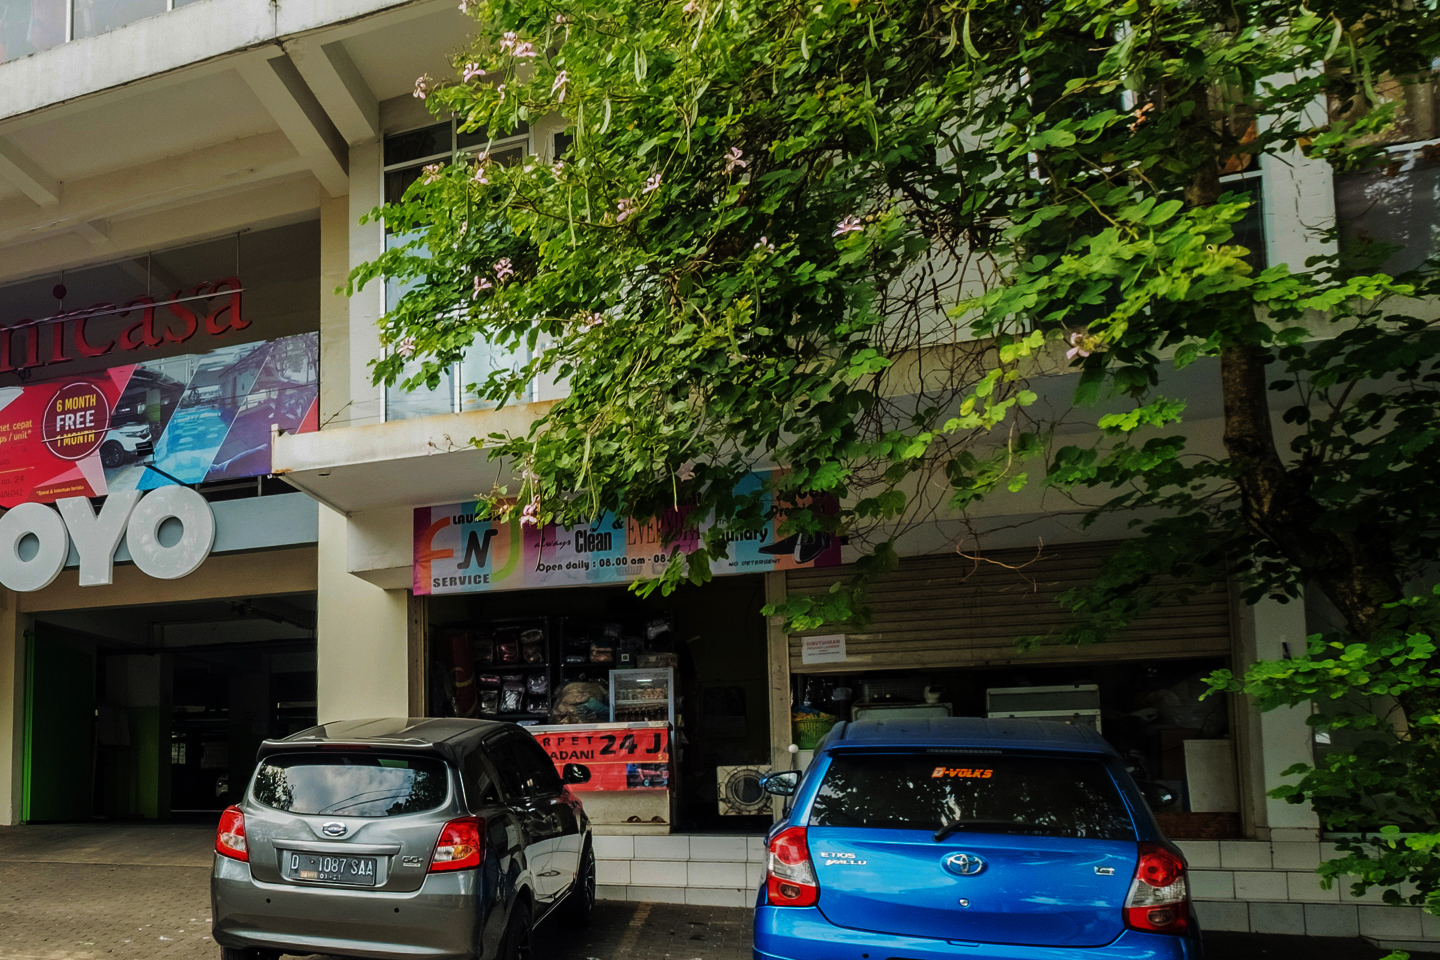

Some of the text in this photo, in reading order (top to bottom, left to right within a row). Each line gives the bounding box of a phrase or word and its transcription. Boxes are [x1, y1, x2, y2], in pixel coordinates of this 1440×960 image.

[56, 394, 97, 413] 6 MONTH
[12, 419, 32, 431] cepat
[56, 410, 95, 431] FREE
[63, 430, 95, 447] MONTH
[14, 475, 24, 484] 24
[612, 517, 624, 529] &
[534, 530, 613, 554] always Clean
[537, 562, 564, 573] Open
[565, 558, 590, 572] daily
[599, 557, 628, 567] 08.00
[630, 556, 646, 566] am
[741, 558, 782, 567] DETERGENT
[433, 573, 490, 588] SERVICE
[599, 734, 638, 755] 24
[550, 750, 594, 760] ADANI
[820, 851, 856, 859] ETIOS
[291, 855, 300, 870] D
[318, 857, 347, 874] 1087
[350, 859, 373, 876] SAA
